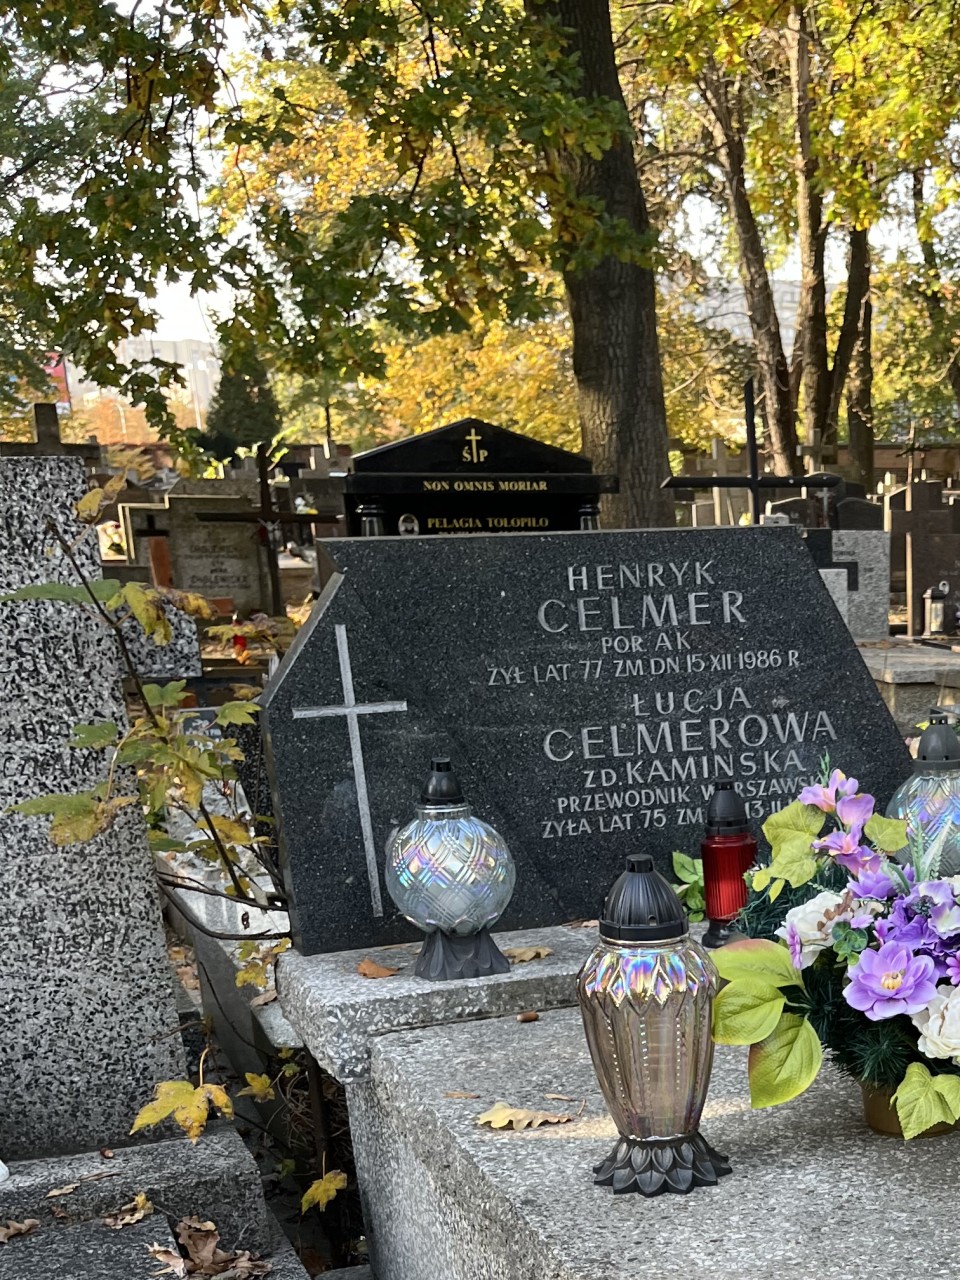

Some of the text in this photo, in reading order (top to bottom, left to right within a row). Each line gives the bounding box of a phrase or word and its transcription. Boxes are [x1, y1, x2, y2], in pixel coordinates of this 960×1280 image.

[423, 481, 548, 491] NON OMNIS MORIAR
[427, 518, 482, 528] PELAGIA
[567, 560, 715, 591] HENRYK
[537, 590, 747, 633] CELMER
[655, 632, 691, 651] AK
[533, 663, 571, 683] LAT
[579, 660, 602, 681] 77
[650, 656, 679, 674] DN
[686, 653, 706, 672] 15
[739, 649, 782, 669] 1986
[630, 686, 752, 716] ŁUCJA
[543, 710, 838, 762] CELMEROWA
[557, 786, 691, 814] PRZEWODNIK
[599, 813, 634, 832] LAT
[640, 808, 667, 829] 75
